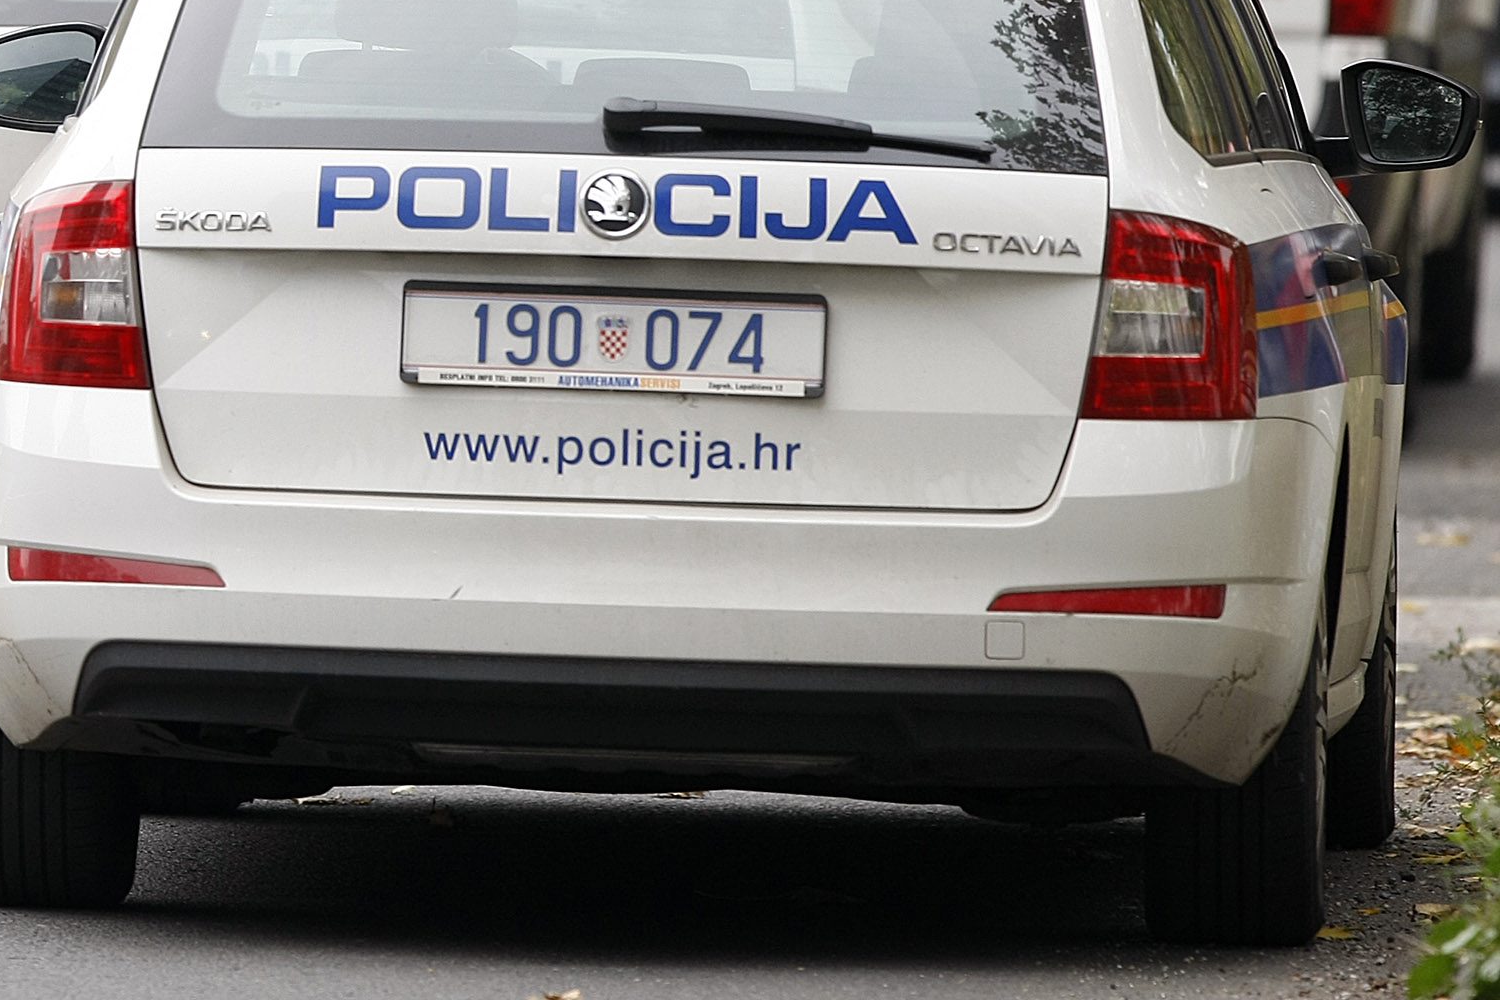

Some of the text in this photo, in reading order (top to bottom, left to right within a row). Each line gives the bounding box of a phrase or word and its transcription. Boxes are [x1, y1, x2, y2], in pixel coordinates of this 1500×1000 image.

[154, 207, 272, 233] ŠKODA
[316, 165, 919, 245] POLICIJA
[932, 232, 1082, 258] OCTAVIA
[474, 302, 765, 374] 190 074
[424, 428, 802, 479] www.policija.hr
